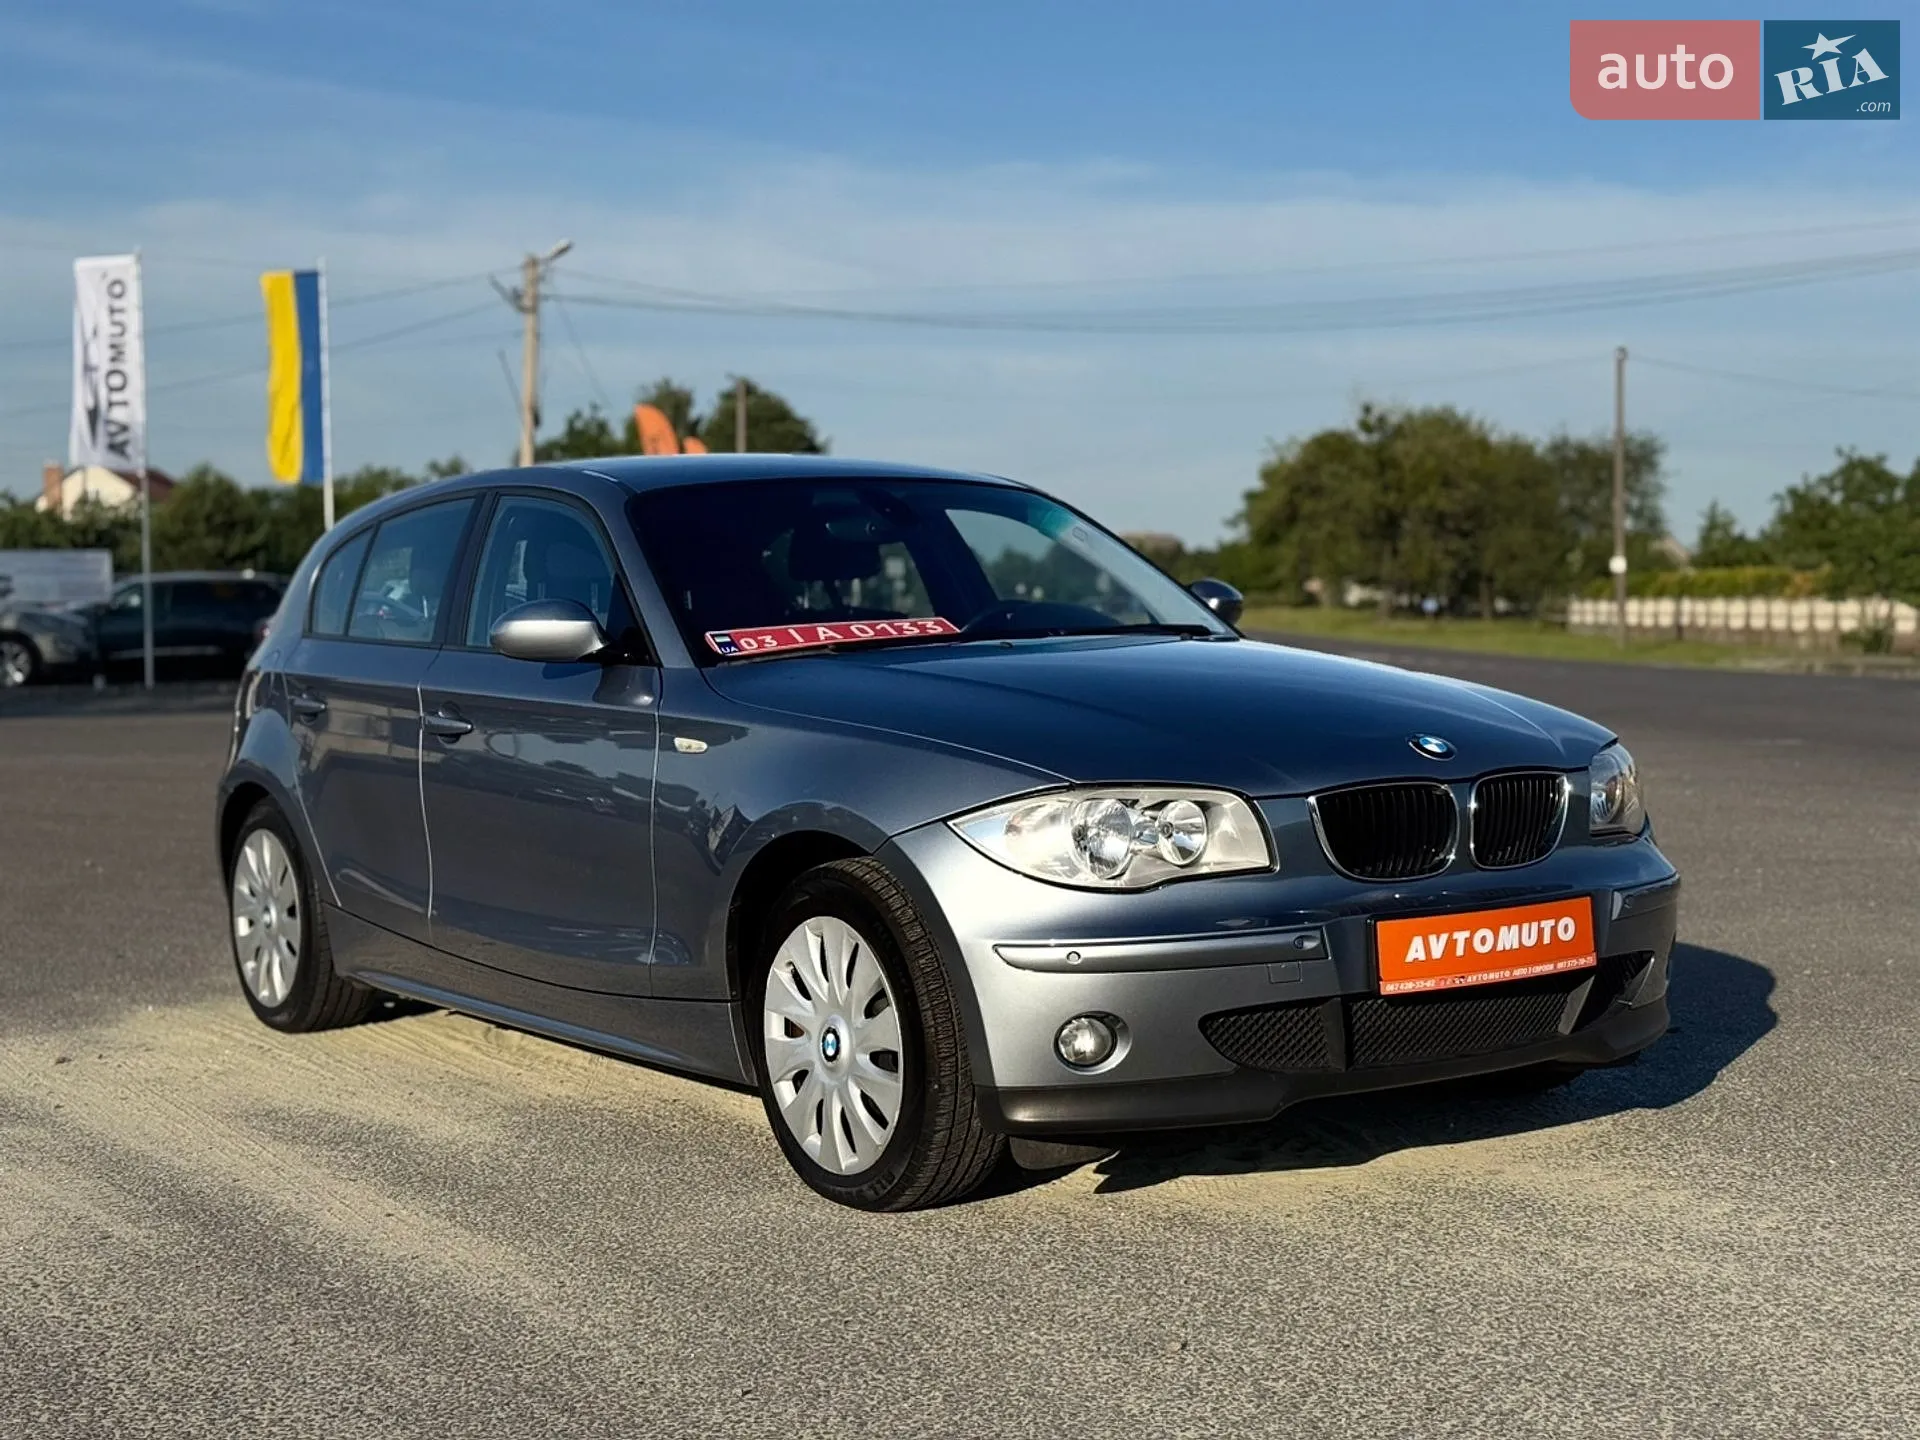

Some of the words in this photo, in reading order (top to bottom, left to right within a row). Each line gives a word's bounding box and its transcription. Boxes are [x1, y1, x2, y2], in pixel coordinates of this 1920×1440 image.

[106, 278, 131, 462] AVTOMUTO
[721, 646, 739, 654] UA
[738, 635, 778, 650] 03
[1404, 916, 1576, 963] AVTOMUTO
